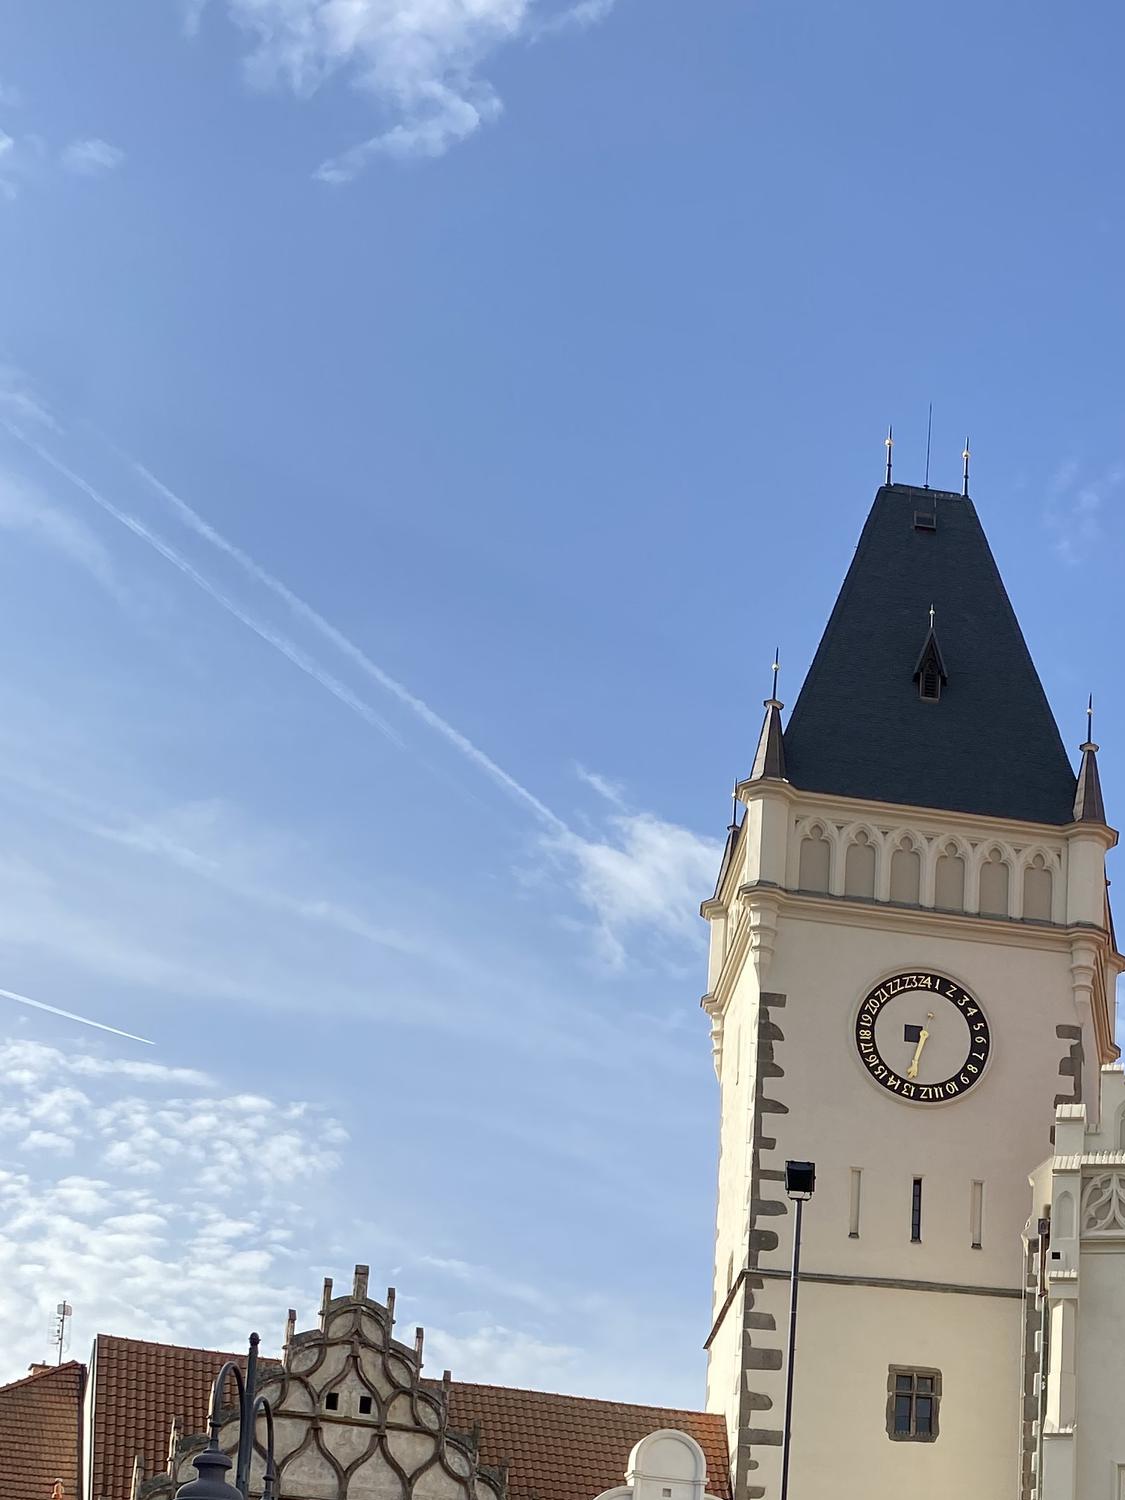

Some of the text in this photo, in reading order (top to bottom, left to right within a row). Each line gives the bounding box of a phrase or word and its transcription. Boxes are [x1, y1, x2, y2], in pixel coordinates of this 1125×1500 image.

[886, 979, 904, 995] 22
[902, 976, 918, 988] 23
[917, 976, 932, 988] 24
[935, 979, 940, 990] 1
[875, 988, 891, 1003] 21
[945, 985, 957, 997] 2
[864, 998, 880, 1014] 20
[957, 996, 969, 1006] 3
[967, 1007, 978, 1017] 4
[859, 1014, 873, 1026] 19
[973, 1022, 984, 1031] 5
[859, 1029, 872, 1040] 18
[974, 1036, 987, 1044] 6
[860, 1042, 873, 1054] 17
[865, 1054, 879, 1067] 16
[971, 1052, 985, 1061] 7
[874, 1065, 888, 1079] 15
[967, 1064, 978, 1074] 8
[887, 1075, 901, 1090] 14
[960, 1073, 969, 1084] 9
[901, 1084, 915, 1097] 13
[919, 1087, 933, 1099] 12
[933, 1086, 944, 1098] 11
[946, 1081, 959, 1094] 10
